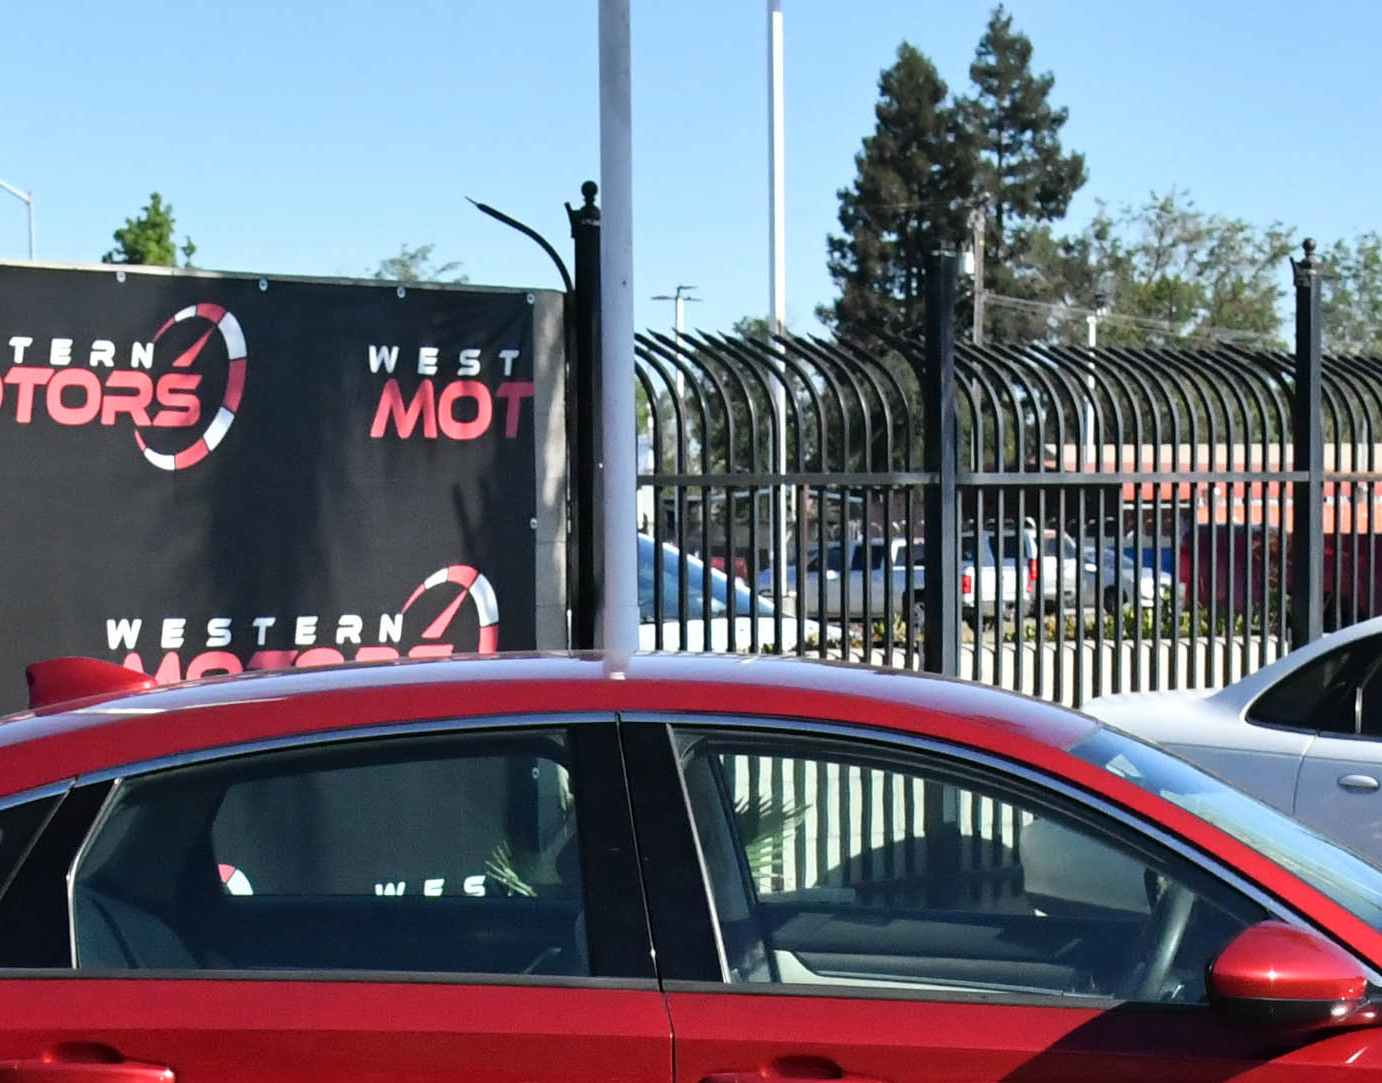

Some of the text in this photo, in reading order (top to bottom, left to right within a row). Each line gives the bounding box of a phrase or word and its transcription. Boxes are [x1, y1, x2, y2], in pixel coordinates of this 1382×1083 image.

[369, 346, 519, 376] WEST
[370, 379, 534, 440] MOT
[106, 613, 404, 650] WESTERN
